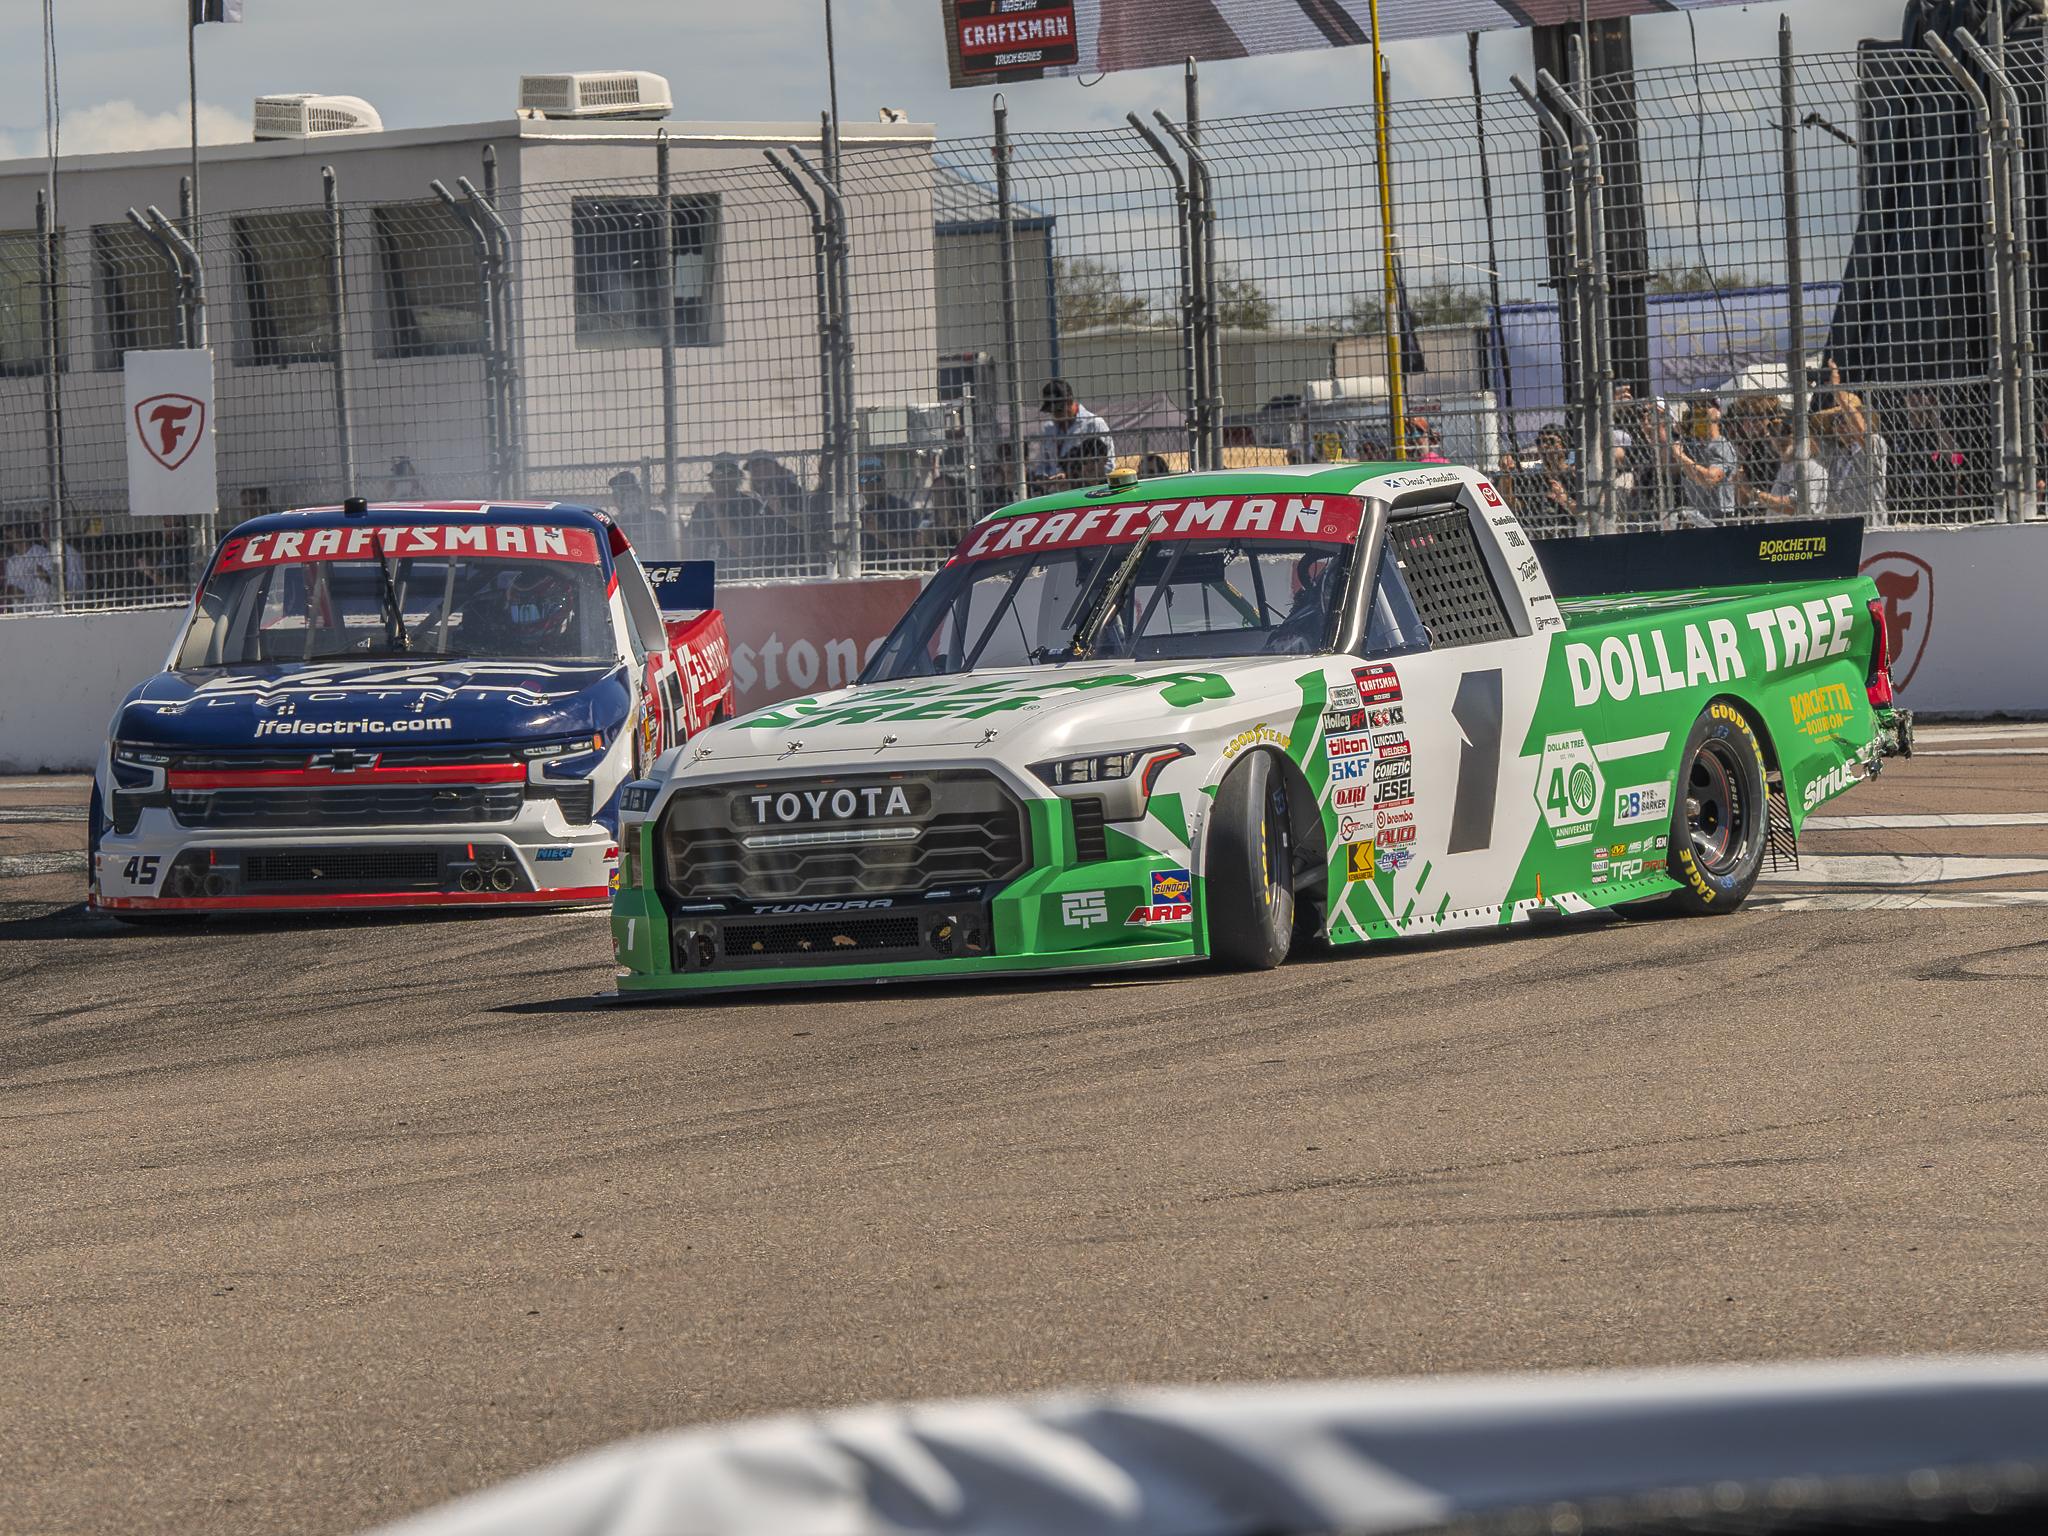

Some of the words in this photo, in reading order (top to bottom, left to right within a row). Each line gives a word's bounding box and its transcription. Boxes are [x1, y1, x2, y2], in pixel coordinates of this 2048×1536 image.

[963, 16, 1069, 47] CRAFTSMAN
[967, 499, 1325, 557] CRAFTSMAN
[241, 526, 569, 564] CRAFTSMAN
[1759, 537, 1826, 556] BORCHETTA
[1771, 552, 1814, 562] BOURBON
[1565, 618, 1746, 707] DOLLAR
[1746, 594, 1854, 672] TREE
[1359, 676, 1398, 692] CRAFTSMAN
[1790, 682, 1854, 725] BORCHETTA
[255, 715, 452, 738] jfelectric.com
[1324, 713, 1351, 731] Holley
[1806, 713, 1844, 735] BOURBON
[1328, 738, 1369, 756] tilton
[1373, 732, 1403, 748] LINCOLN
[1381, 745, 1408, 757] WELDERS
[1547, 741, 1570, 752] DOLLAR
[1570, 739, 1584, 749] TREE
[1332, 758, 1369, 781] SKF
[1374, 760, 1410, 779] COMETIC
[1449, 669, 1503, 855] 1
[1374, 779, 1415, 803] JESEL
[751, 786, 912, 824] TOYOTA
[1641, 799, 1667, 811] BARKER
[1386, 810, 1413, 825] brembo
[1376, 825, 1416, 847] CALICO
[1556, 823, 1593, 837] ANNIVERSARY
[123, 856, 162, 885] 45
[1610, 858, 1643, 881] TRD
[1679, 848, 1717, 904] EAGLE
[1154, 882, 1189, 893] SUNOCO
[752, 898, 894, 915] TUNDRA
[1126, 905, 1193, 924] ARP
[627, 918, 636, 951] 1
